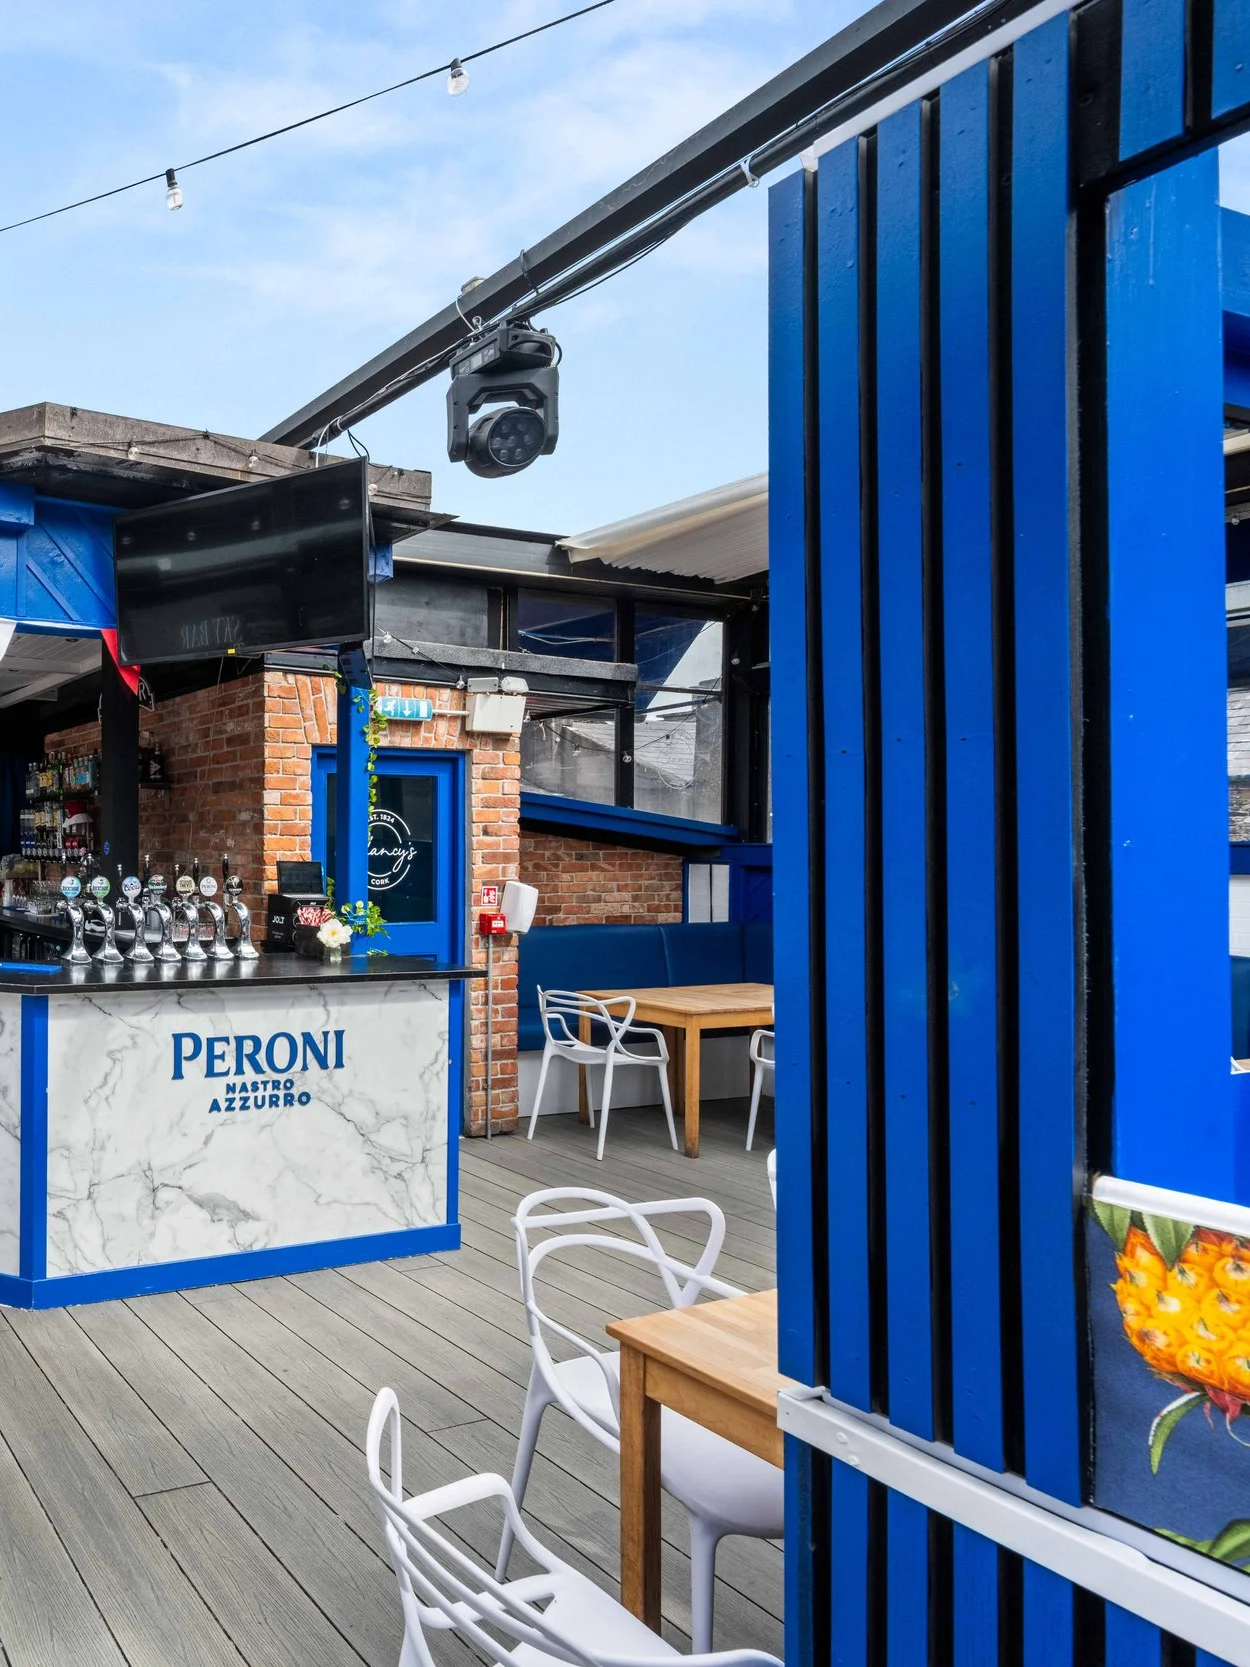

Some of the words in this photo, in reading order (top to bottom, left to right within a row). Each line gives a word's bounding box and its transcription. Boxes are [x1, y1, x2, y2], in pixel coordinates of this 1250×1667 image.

[380, 813, 395, 824] 1824
[370, 877, 390, 886] CORK
[272, 914, 286, 925] JOLT
[171, 1029, 346, 1081] PERONI
[225, 1078, 295, 1095] NASTRO
[208, 1091, 312, 1114] AZZURRO
